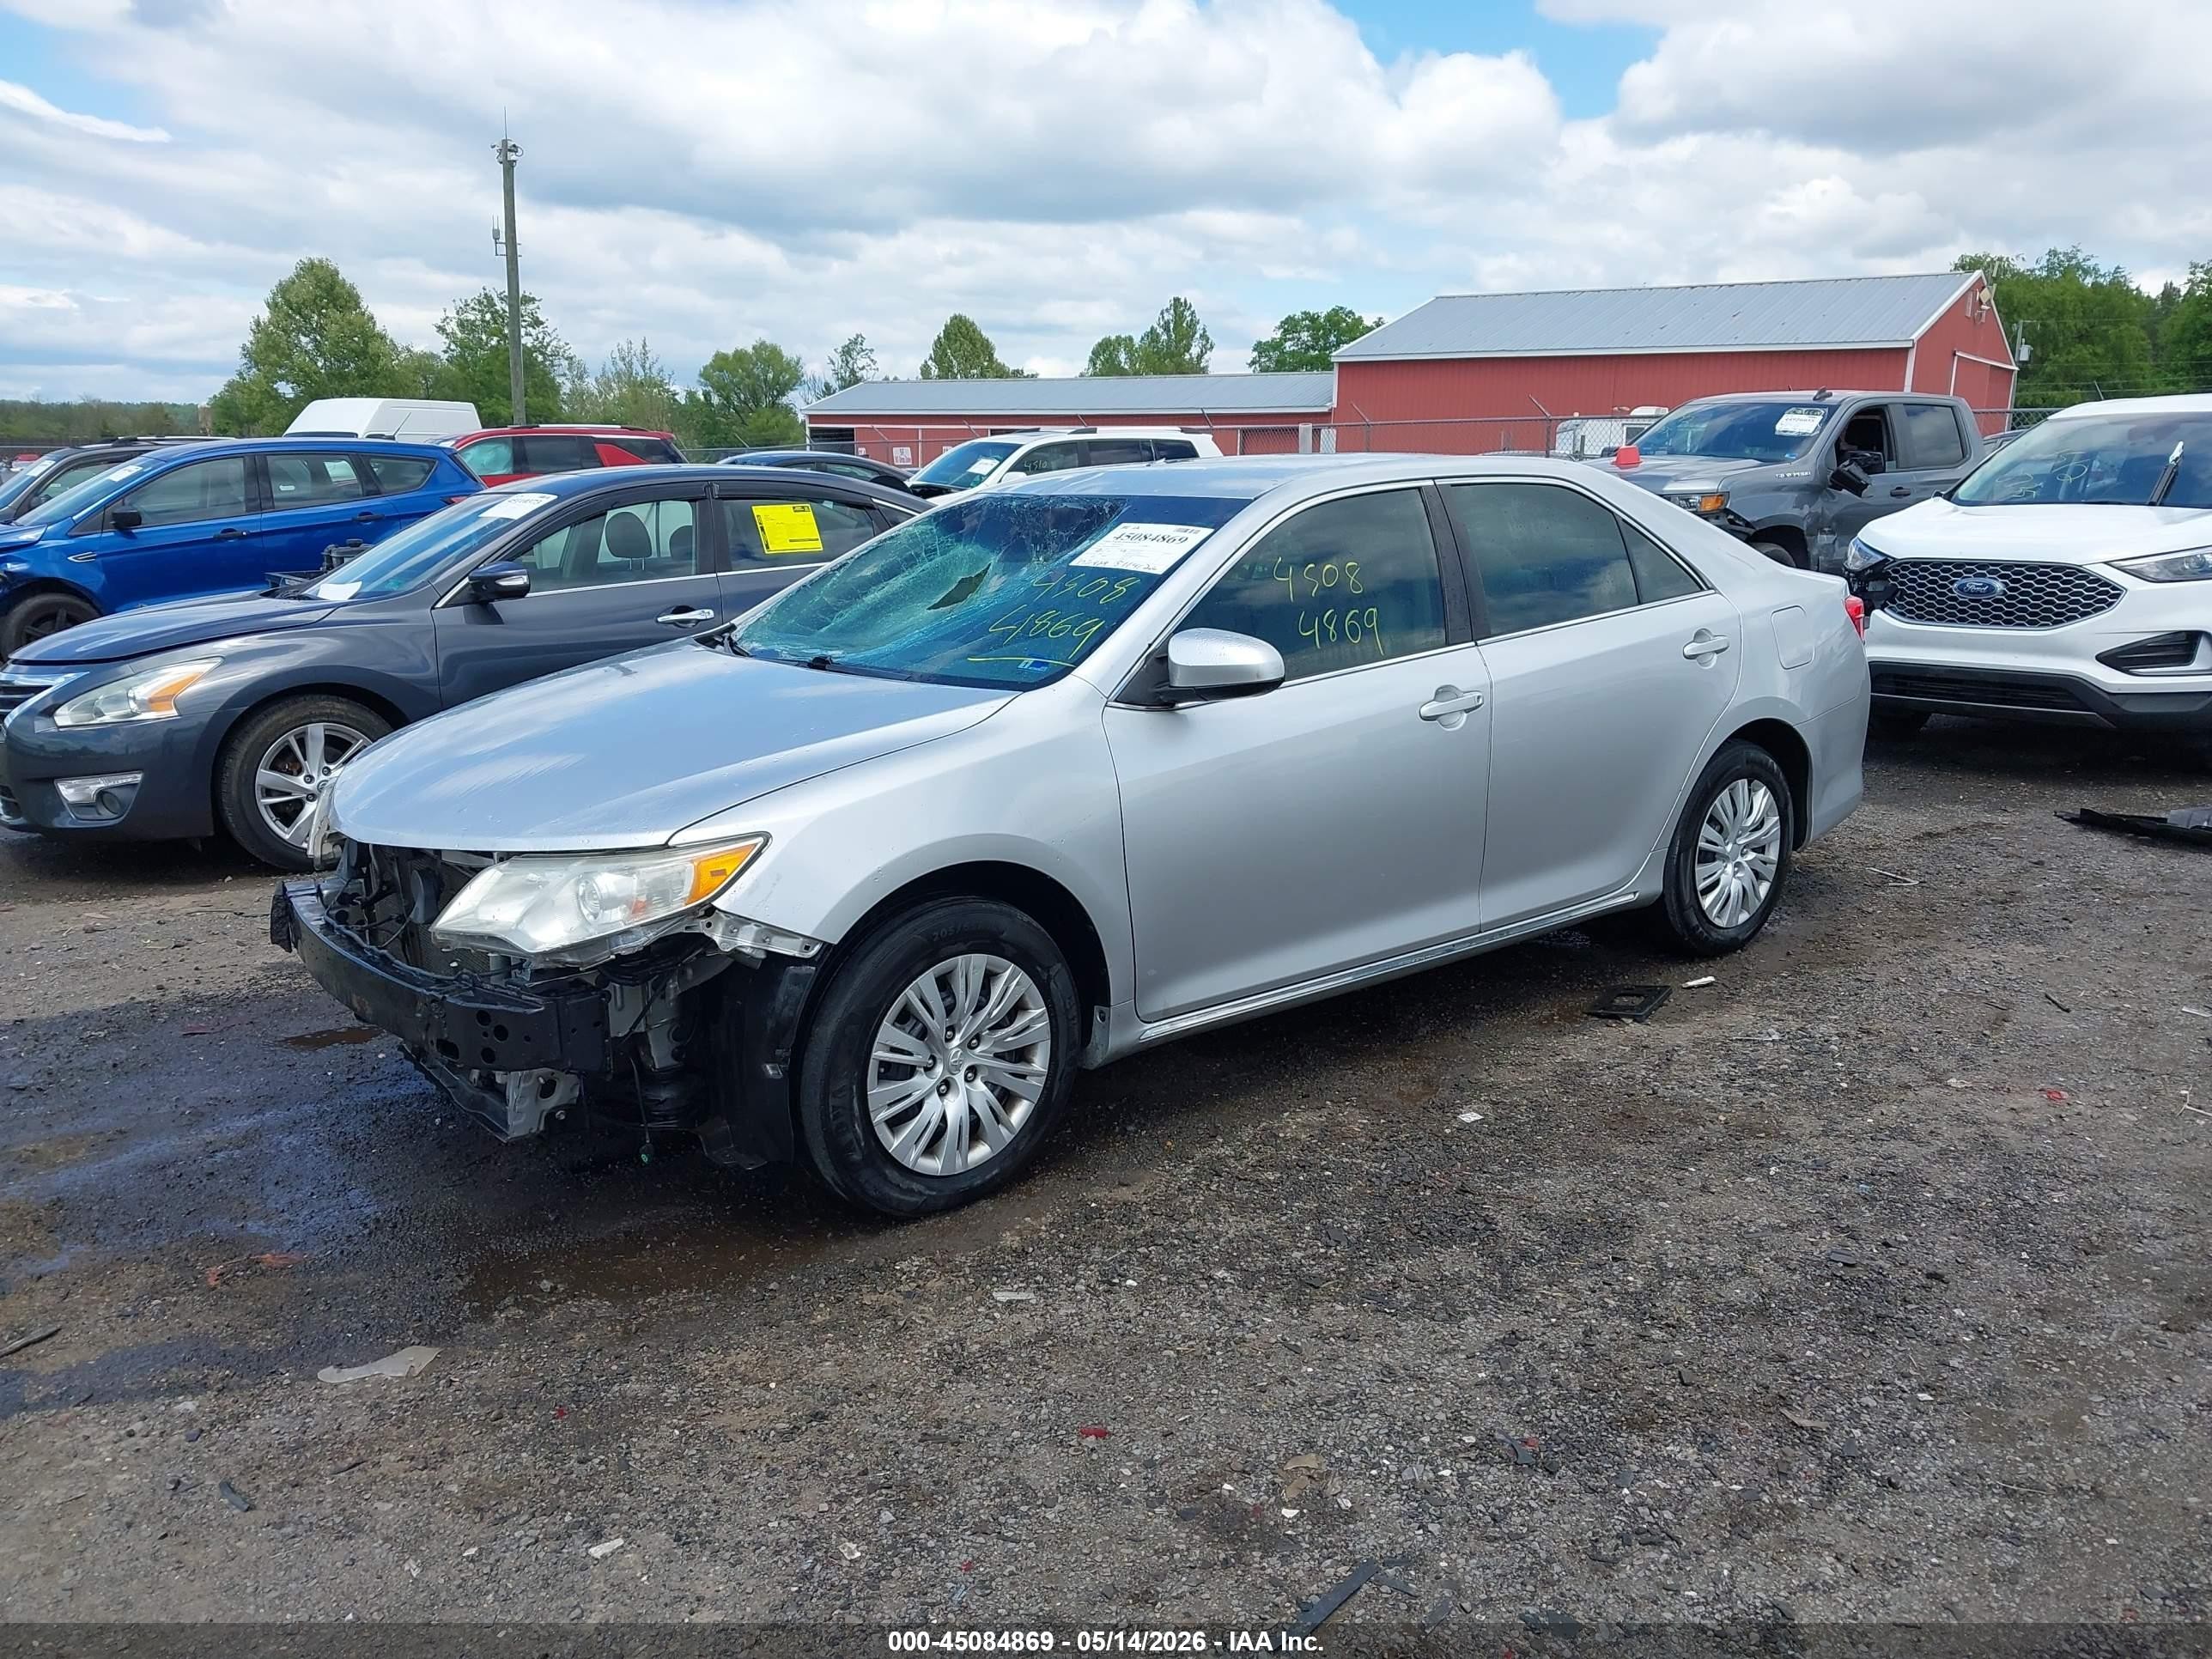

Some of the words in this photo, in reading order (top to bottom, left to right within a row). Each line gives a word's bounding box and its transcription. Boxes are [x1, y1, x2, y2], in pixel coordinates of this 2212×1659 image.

[1113, 532, 1188, 544] 45084869
[1033, 571, 1140, 605] 4508
[1273, 556, 1364, 602] 4508
[1963, 581, 1990, 593] Ford
[989, 605, 1105, 659] 4869
[1298, 607, 1384, 656] 4869
